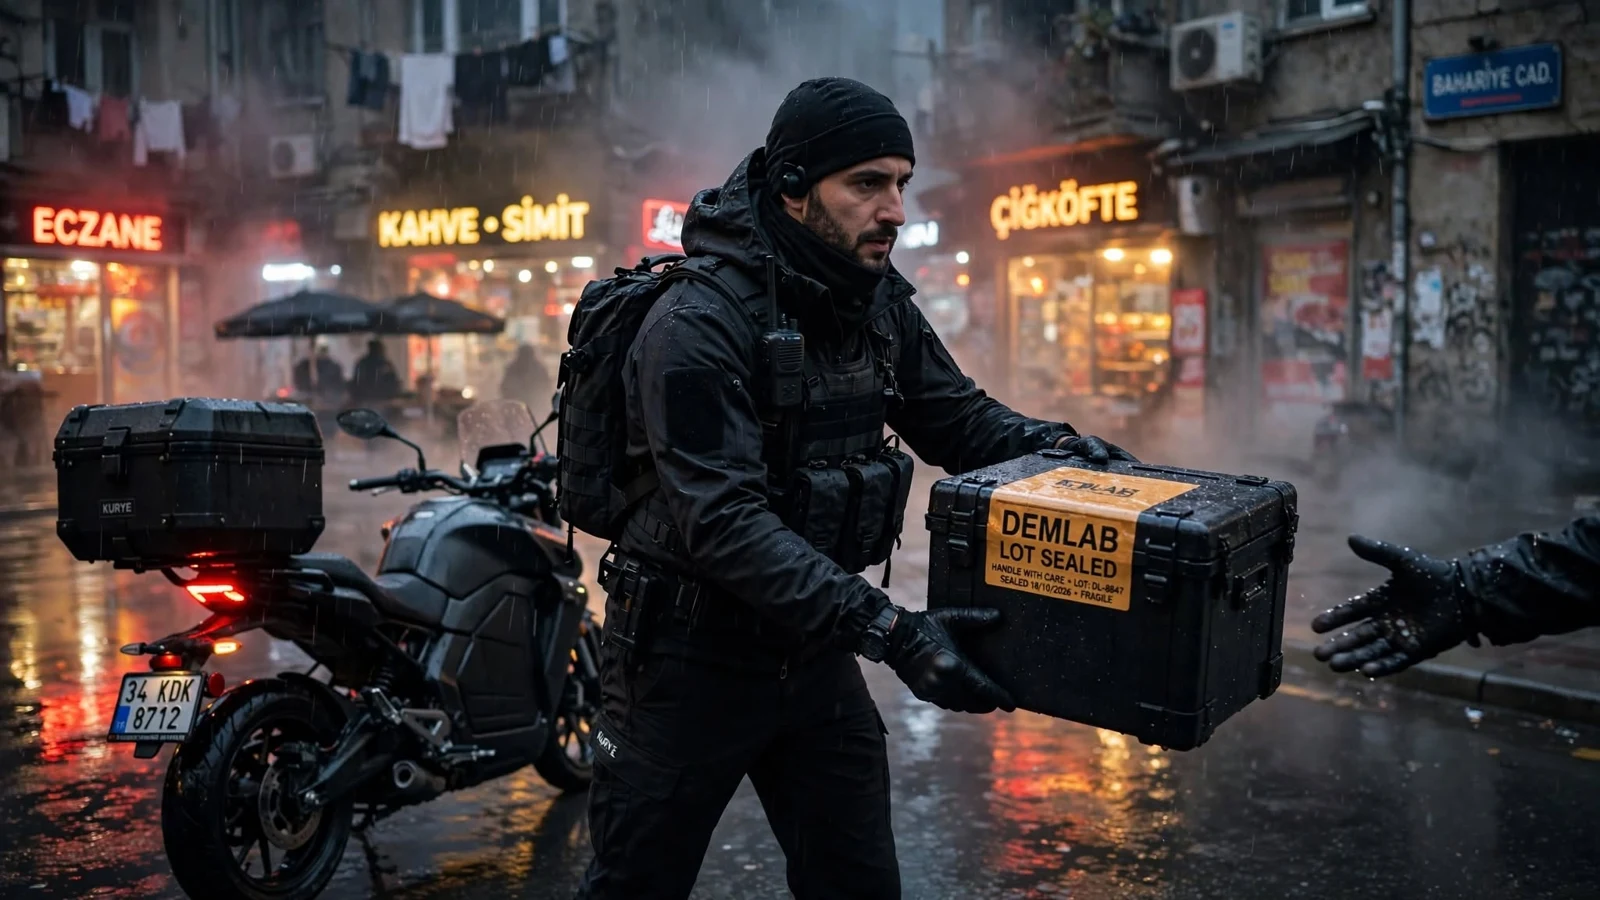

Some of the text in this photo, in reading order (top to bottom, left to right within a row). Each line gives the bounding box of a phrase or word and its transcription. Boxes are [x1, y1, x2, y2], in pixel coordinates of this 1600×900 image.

[1515, 61, 1553, 87] CAD.
[378, 193, 590, 248] KAHVE SİMİT
[990, 178, 1139, 241] ÇİĞKÖFTE
[33, 206, 163, 251] ECZANE
[102, 502, 132, 514] KURYE
[1002, 509, 1118, 553] DEMLAB
[1000, 541, 1117, 579] LOT SEALED
[991, 563, 1022, 576] HANDLE
[1023, 569, 1043, 580] WITH
[1044, 572, 1065, 585] CARE
[1073, 578, 1091, 590] LOT:
[1000, 575, 1113, 604] SEALED 18/10/2026 FRAGILE
[125, 679, 195, 703] 34 KDK
[133, 706, 181, 730] 8712
